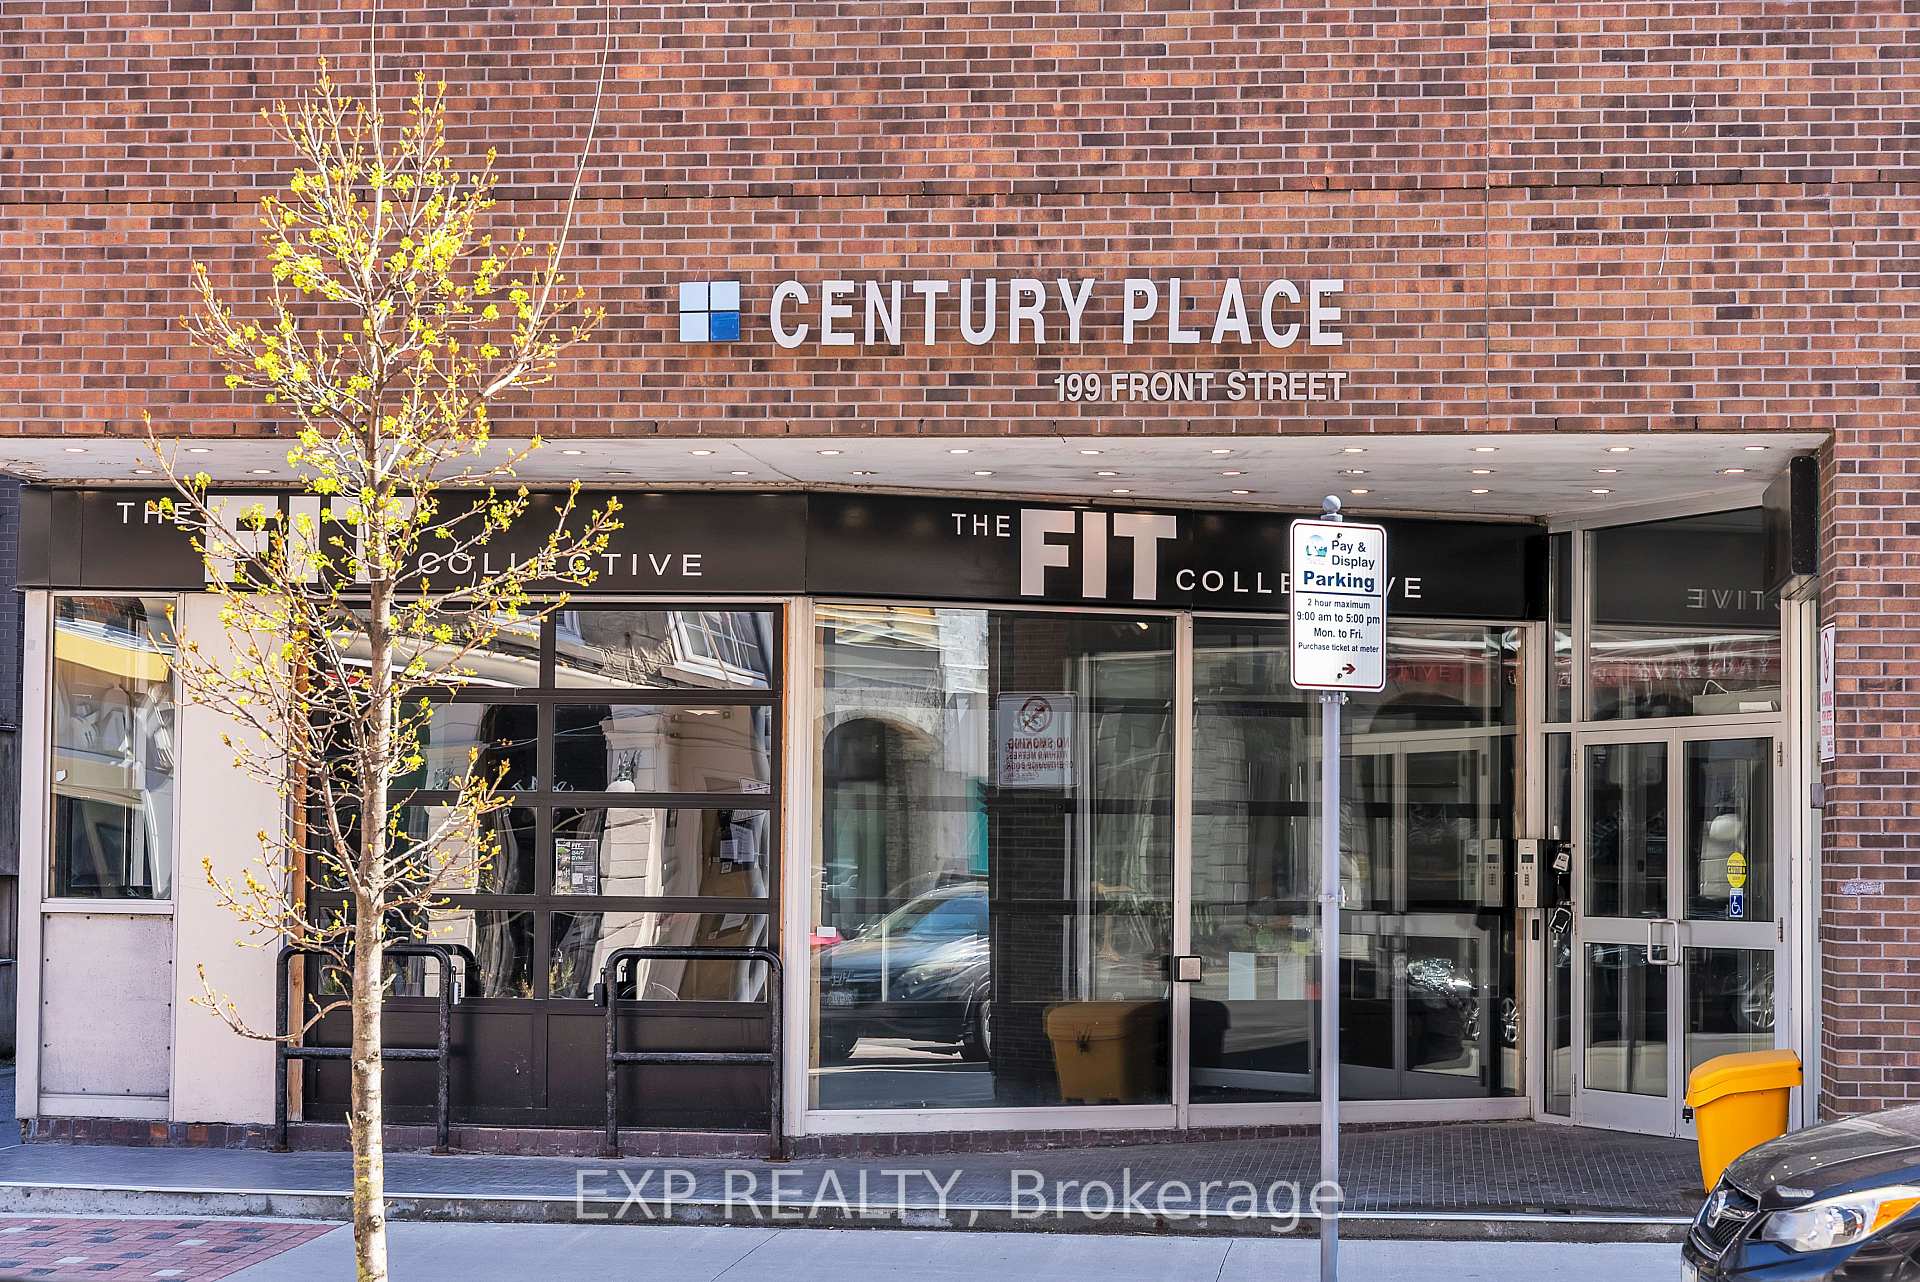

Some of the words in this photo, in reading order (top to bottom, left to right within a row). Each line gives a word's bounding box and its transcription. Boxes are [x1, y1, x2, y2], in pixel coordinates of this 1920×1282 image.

[769, 278, 1094, 349] CENTURY
[1122, 277, 1344, 349] PLACE
[1053, 373, 1100, 402] 199
[1111, 372, 1214, 401] FRONT
[1226, 371, 1348, 401] STREET
[116, 502, 192, 525] THE
[204, 495, 415, 584] FIT
[418, 552, 703, 577] COLLECTIVE
[1331, 539, 1354, 554] Pay
[1357, 541, 1367, 553] &
[951, 512, 1011, 538] THE
[1020, 508, 1177, 600] FIT
[1331, 555, 1376, 570] Display
[1303, 570, 1375, 593] Parking
[1307, 598, 1312, 606] 2
[1314, 599, 1332, 607] hour
[1334, 600, 1371, 609] maximum
[1296, 611, 1316, 621] 9:00
[1318, 613, 1332, 622] am
[1334, 613, 1344, 622] to
[1346, 613, 1364, 624] 5:00
[1366, 615, 1380, 627] pm
[1313, 627, 1336, 638] Mon.
[1338, 629, 1347, 639] to
[1349, 629, 1363, 640] Fri.
[1298, 642, 1330, 651] Purchase
[1331, 643, 1350, 652] ticket
[1352, 644, 1358, 652] at
[1359, 645, 1379, 653] meter
